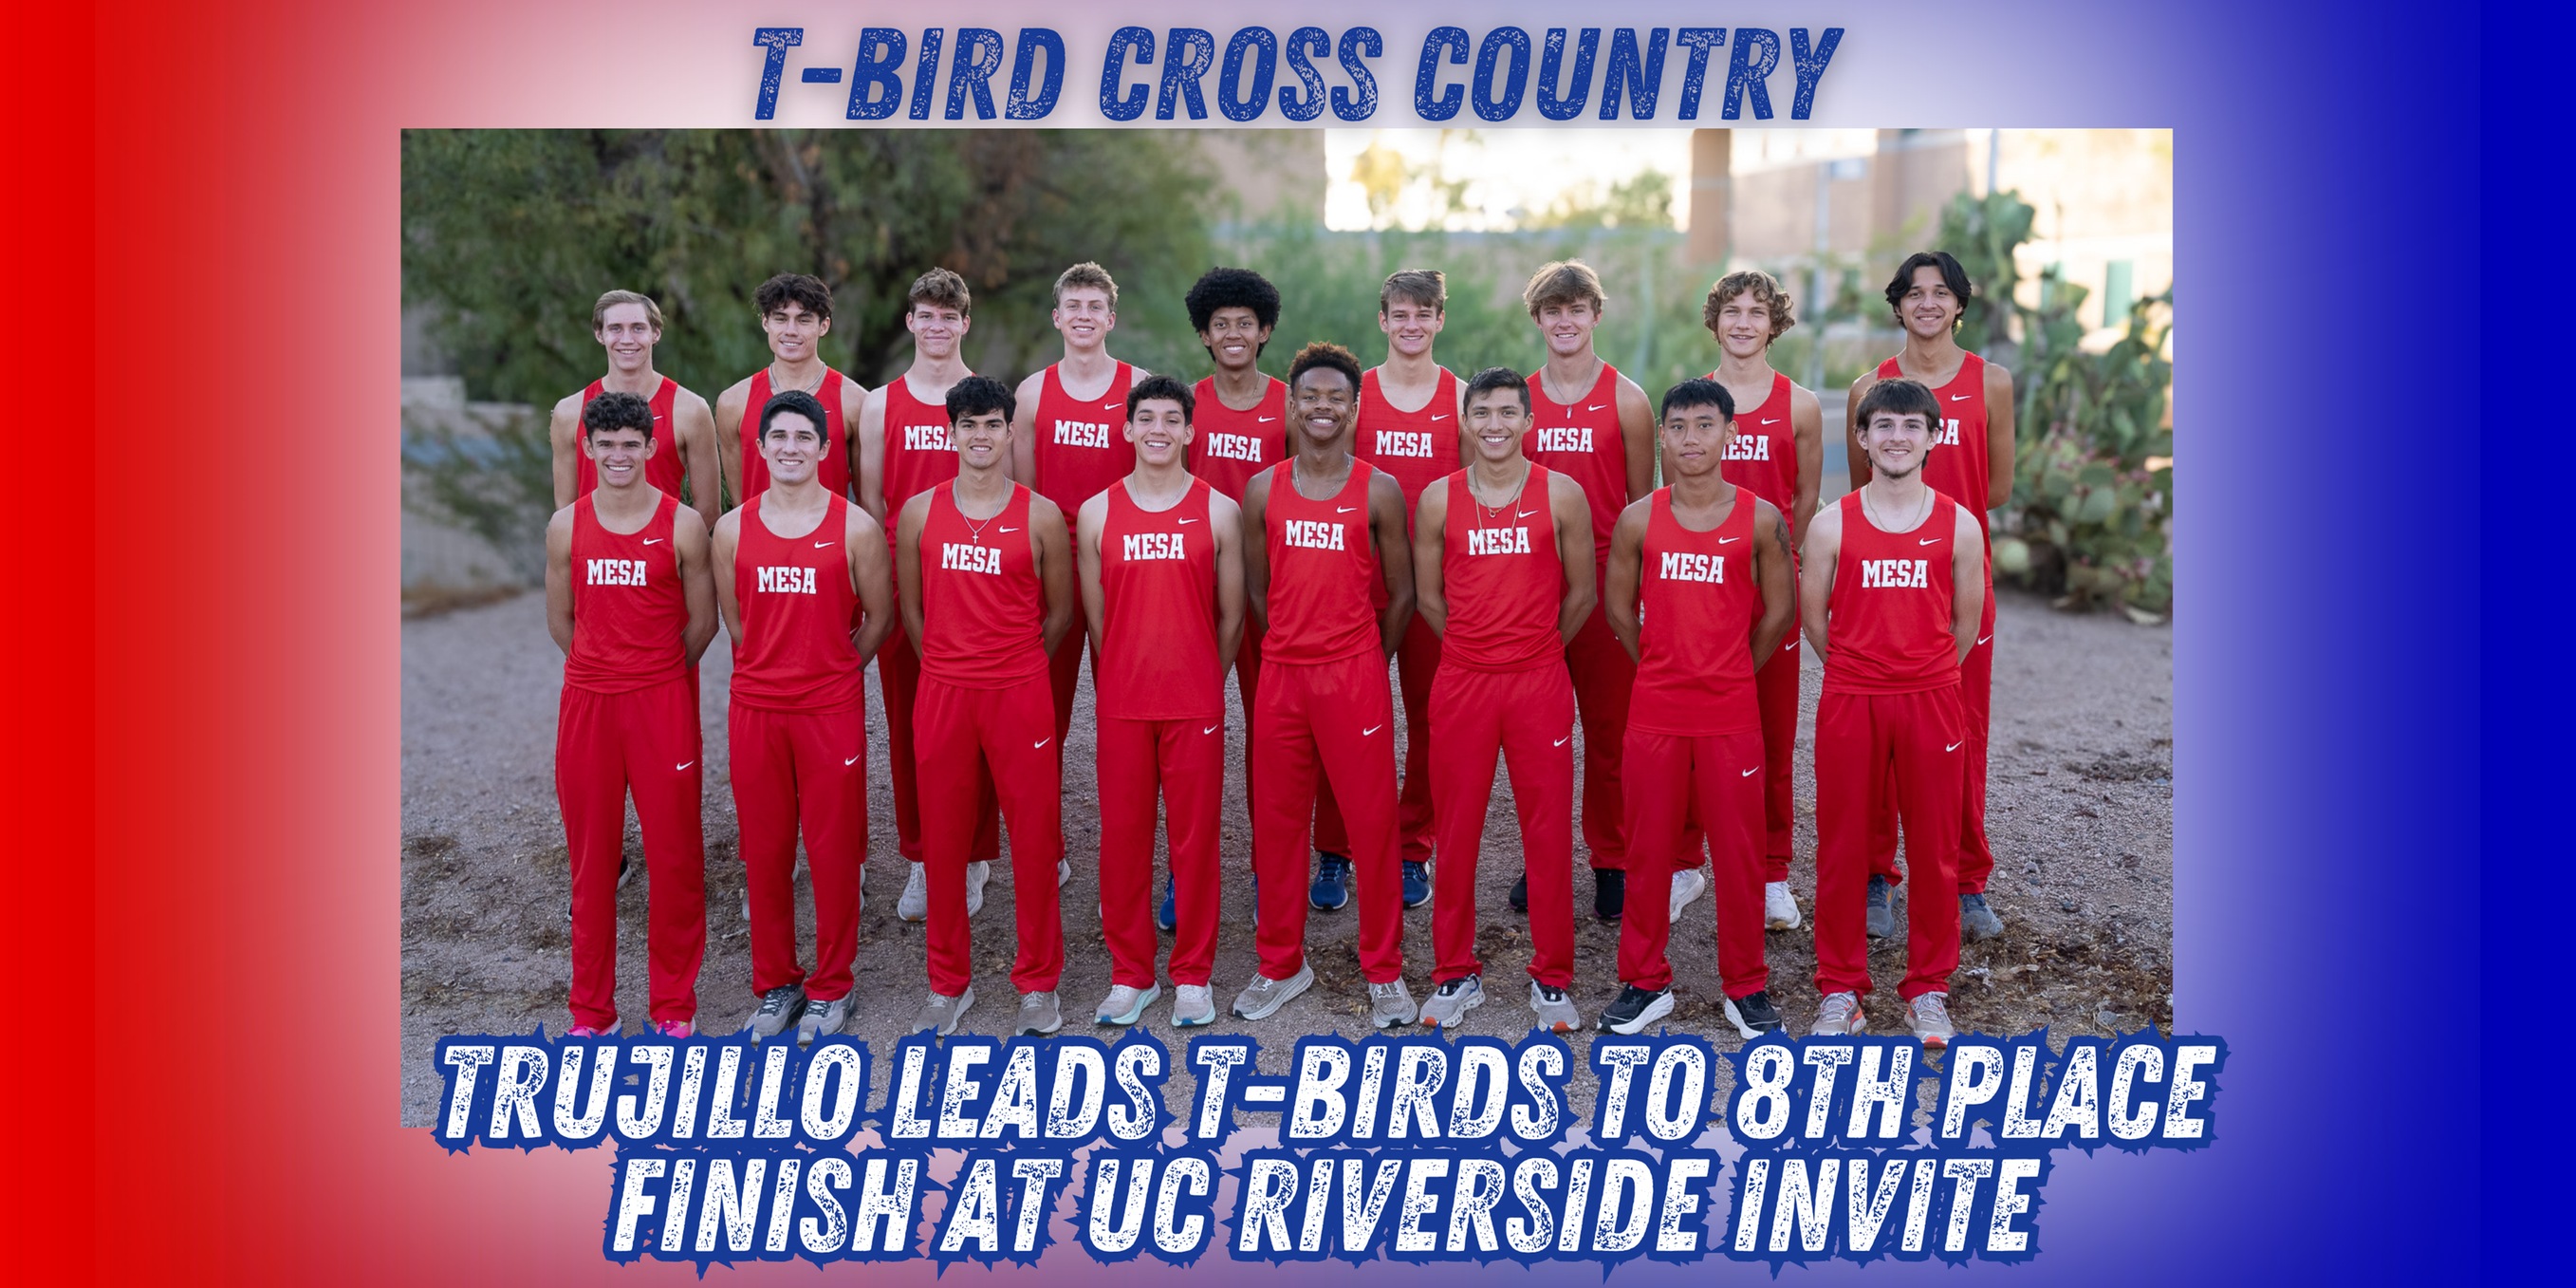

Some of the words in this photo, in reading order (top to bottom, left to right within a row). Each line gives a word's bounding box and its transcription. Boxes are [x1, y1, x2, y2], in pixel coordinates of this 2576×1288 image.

[1053, 420, 1110, 449] MESA
[1207, 433, 1262, 463] MESA
[1376, 430, 1434, 457] MESA
[1537, 427, 1594, 453] MESA
[1720, 434, 1770, 461] ESA
[1123, 532, 1186, 562] MESA
[1285, 520, 1345, 551] MESA
[1468, 526, 1531, 555] MESA
[586, 558, 647, 587] MESA
[941, 543, 1002, 575] MESA
[1660, 551, 1725, 585] MESA
[1862, 559, 1928, 588] MESA
[757, 566, 817, 595] MESA
